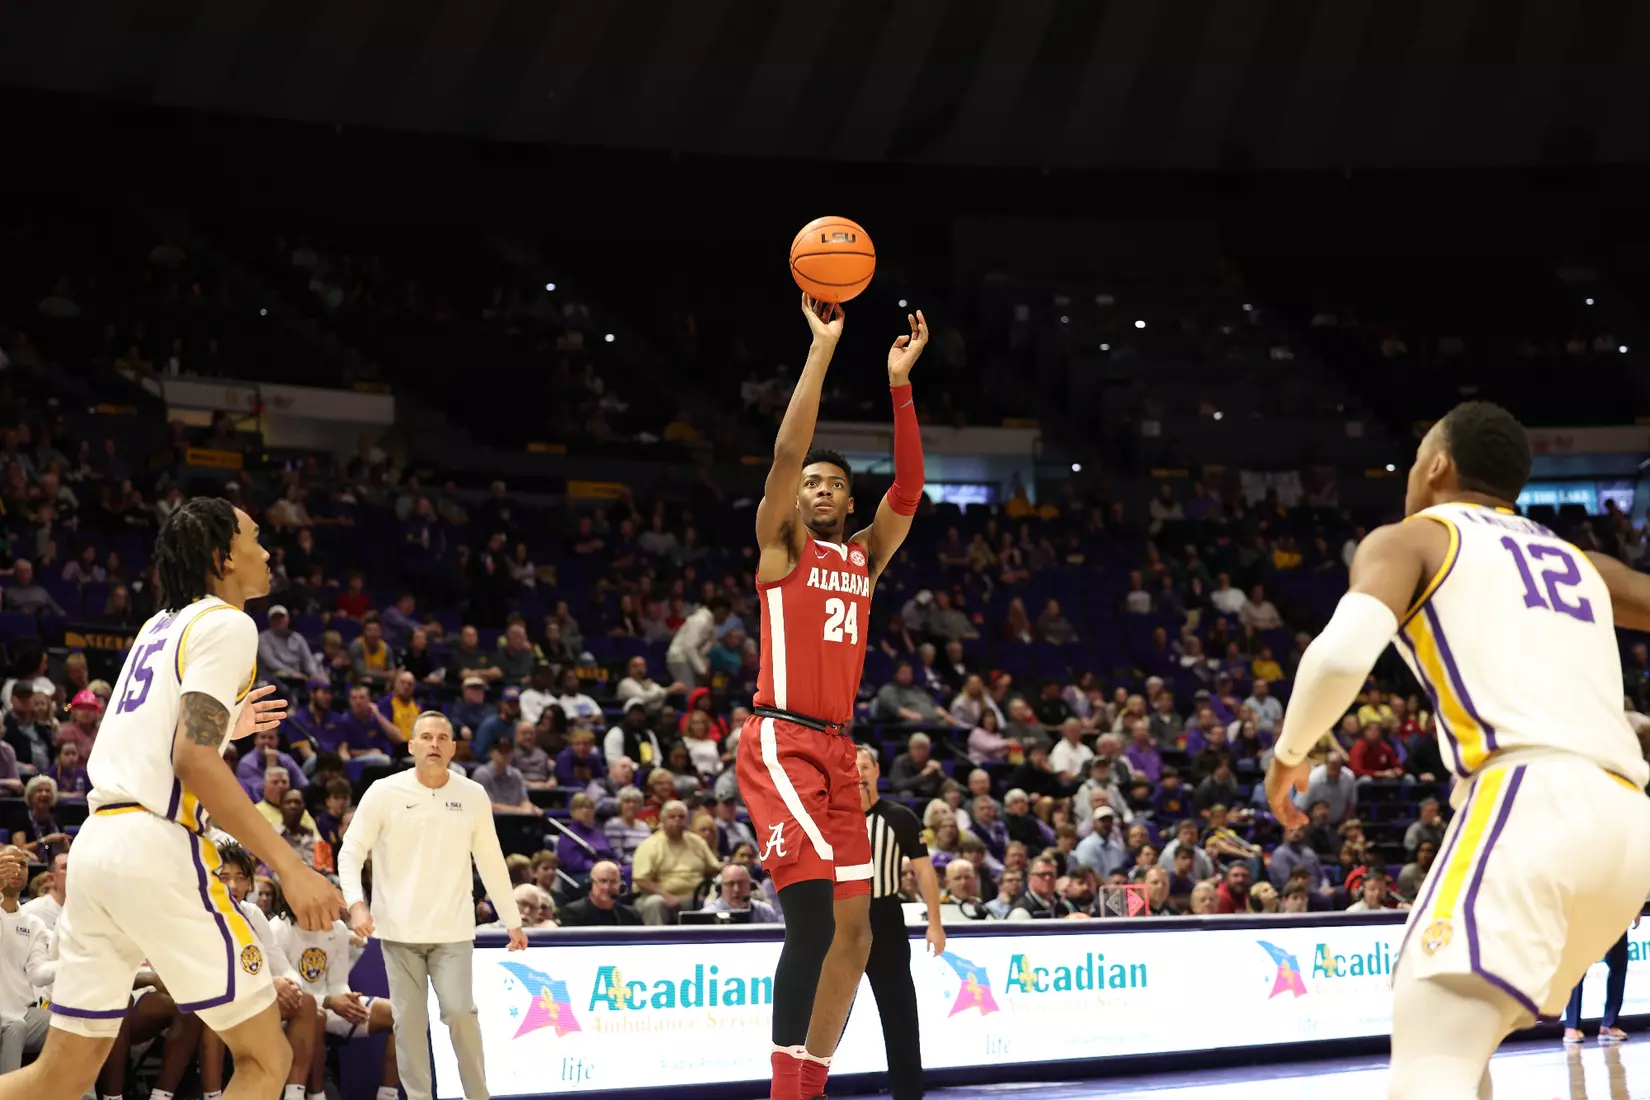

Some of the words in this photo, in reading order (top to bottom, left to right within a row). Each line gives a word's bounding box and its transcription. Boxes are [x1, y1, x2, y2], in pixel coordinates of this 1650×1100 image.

[821, 232, 856, 243] LSU
[1500, 535, 1595, 623] 12
[823, 597, 858, 645] 24
[116, 638, 167, 715] 15
[588, 963, 773, 1012] Acadian
[1005, 951, 1149, 995] Acadian
[560, 1056, 595, 1087] life
